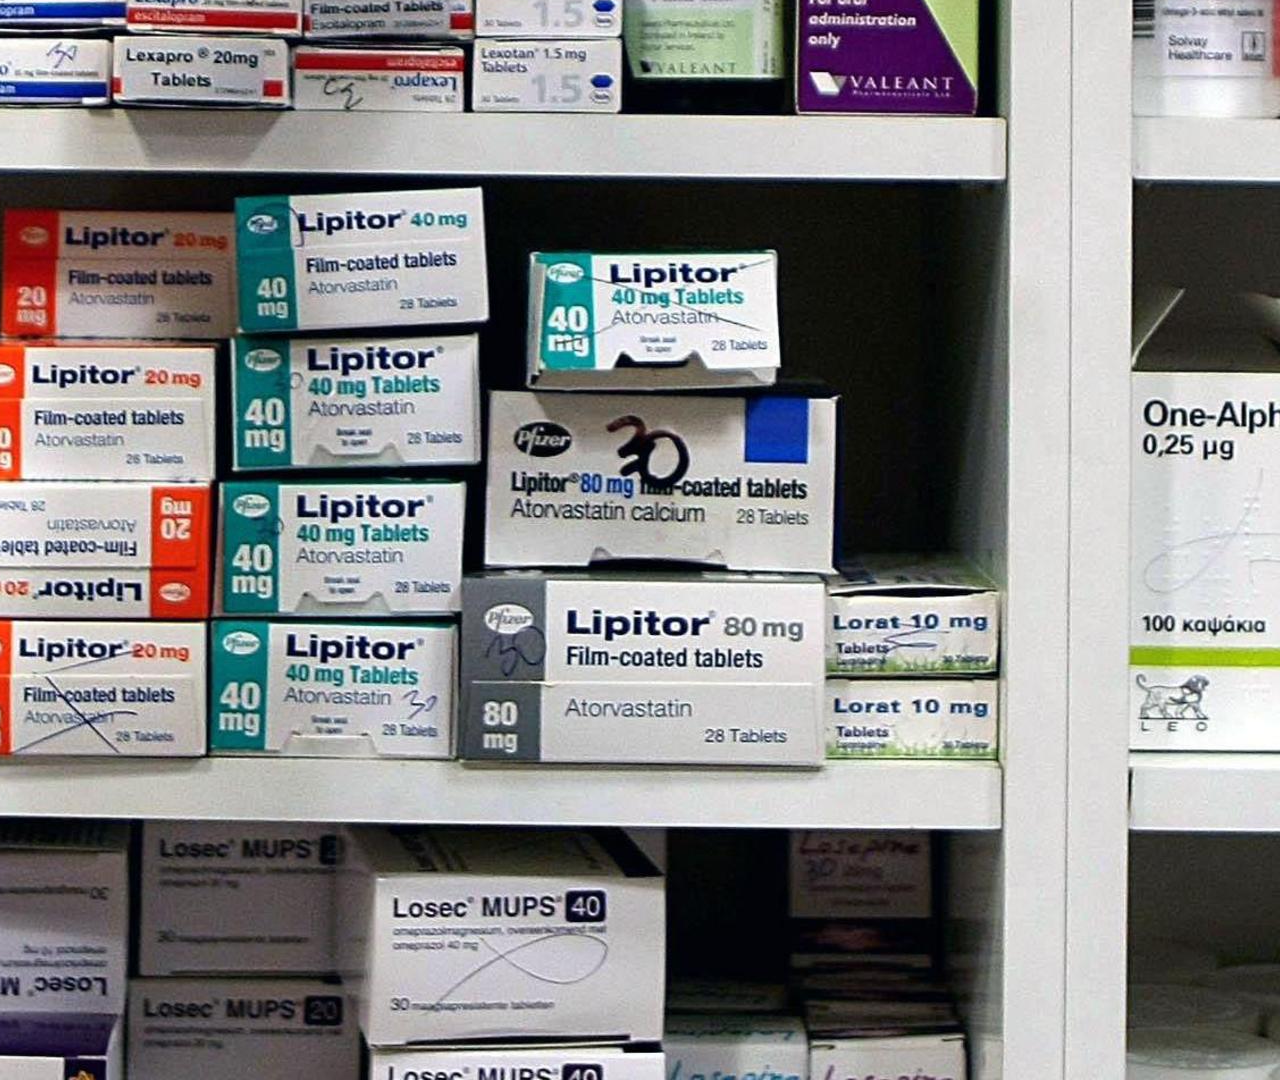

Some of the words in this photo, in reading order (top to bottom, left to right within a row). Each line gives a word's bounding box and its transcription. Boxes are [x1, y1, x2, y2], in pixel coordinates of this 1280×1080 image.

[808, 12, 917, 28] administration
[808, 33, 841, 49] only
[1168, 35, 1209, 50] Solvay
[126, 48, 195, 66] Lexapro
[213, 49, 258, 68] 20mg
[1168, 48, 1232, 62] Healthcare
[151, 72, 212, 89] Tablets
[848, 75, 954, 92] VALEANT
[32, 364, 135, 389] Lipitor
[144, 370, 168, 386] 20
[173, 372, 202, 390] mg
[34, 409, 126, 427] Film-coated
[131, 409, 184, 426] tablets
[34, 432, 124, 447] Atorvastatin
[515, 428, 571, 451] Pfizer
[1143, 432, 1196, 459] 0,25
[1202, 436, 1235, 461] µg
[296, 496, 425, 522] Lipitor
[511, 499, 630, 520] Atorvastatin
[633, 501, 705, 523] calcium
[736, 509, 754, 524] 28
[758, 509, 808, 525] Tablets
[296, 525, 322, 542] 40
[326, 526, 355, 546] mg
[361, 524, 429, 542] Tablets
[296, 546, 403, 564] Atorvastatin
[395, 580, 410, 593] 28
[412, 580, 450, 593] Tablets
[566, 611, 711, 638] Lipitor
[724, 619, 757, 637] 80
[762, 621, 804, 642] mg
[1142, 617, 1176, 635] 100
[1182, 616, 1265, 639] καψάκια
[566, 648, 688, 668] Film-coated
[694, 649, 763, 668] tablets
[565, 698, 692, 718] Atorvastatin
[833, 699, 900, 714] Lorat
[911, 699, 939, 714] 10
[950, 700, 989, 718] mg
[705, 729, 725, 742] 28
[730, 729, 787, 743] Tablets
[392, 894, 469, 919] Losec
[481, 895, 556, 918] MUPS
[571, 895, 601, 917] 40
